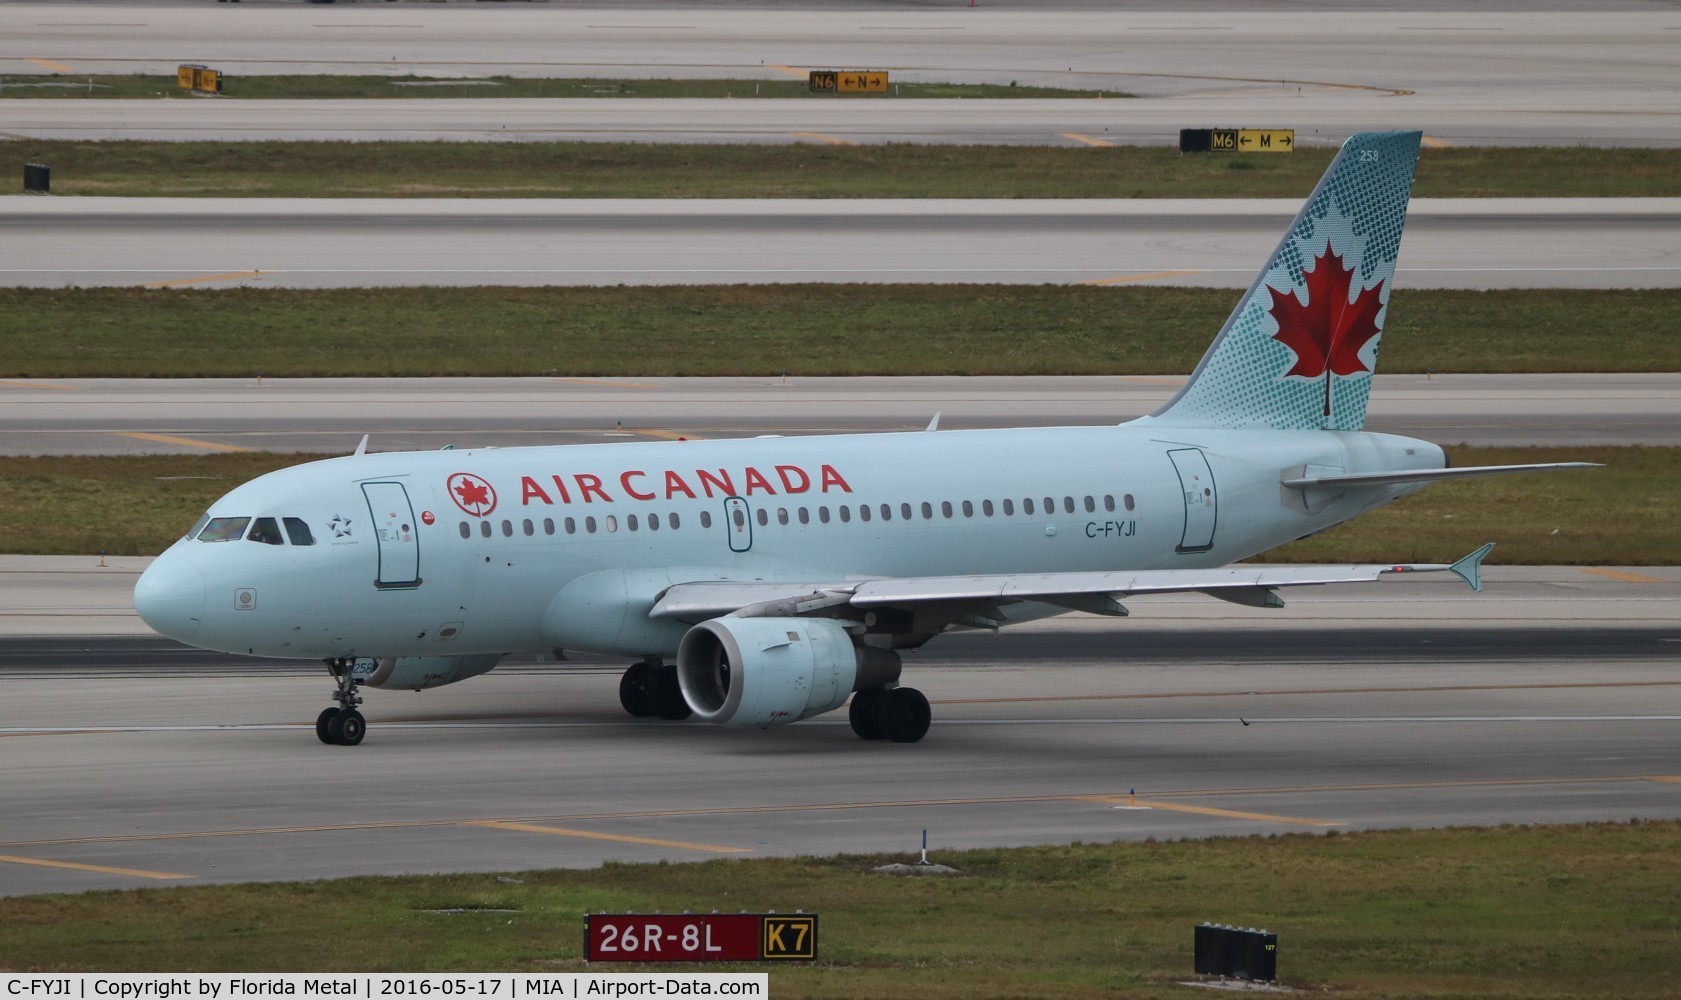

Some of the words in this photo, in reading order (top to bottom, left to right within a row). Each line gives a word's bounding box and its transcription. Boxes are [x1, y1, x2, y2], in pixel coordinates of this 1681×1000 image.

[814, 75, 834, 89] N6
[857, 75, 867, 89] N
[1213, 133, 1234, 148] M6
[1260, 134, 1271, 148] M
[1360, 150, 1379, 161] 258
[521, 474, 615, 506] AIR
[620, 464, 854, 501] CANADA
[1085, 520, 1136, 539] C-FYJI
[353, 662, 373, 674] 258
[600, 924, 722, 952] 26R-8L
[768, 923, 809, 951] K7
